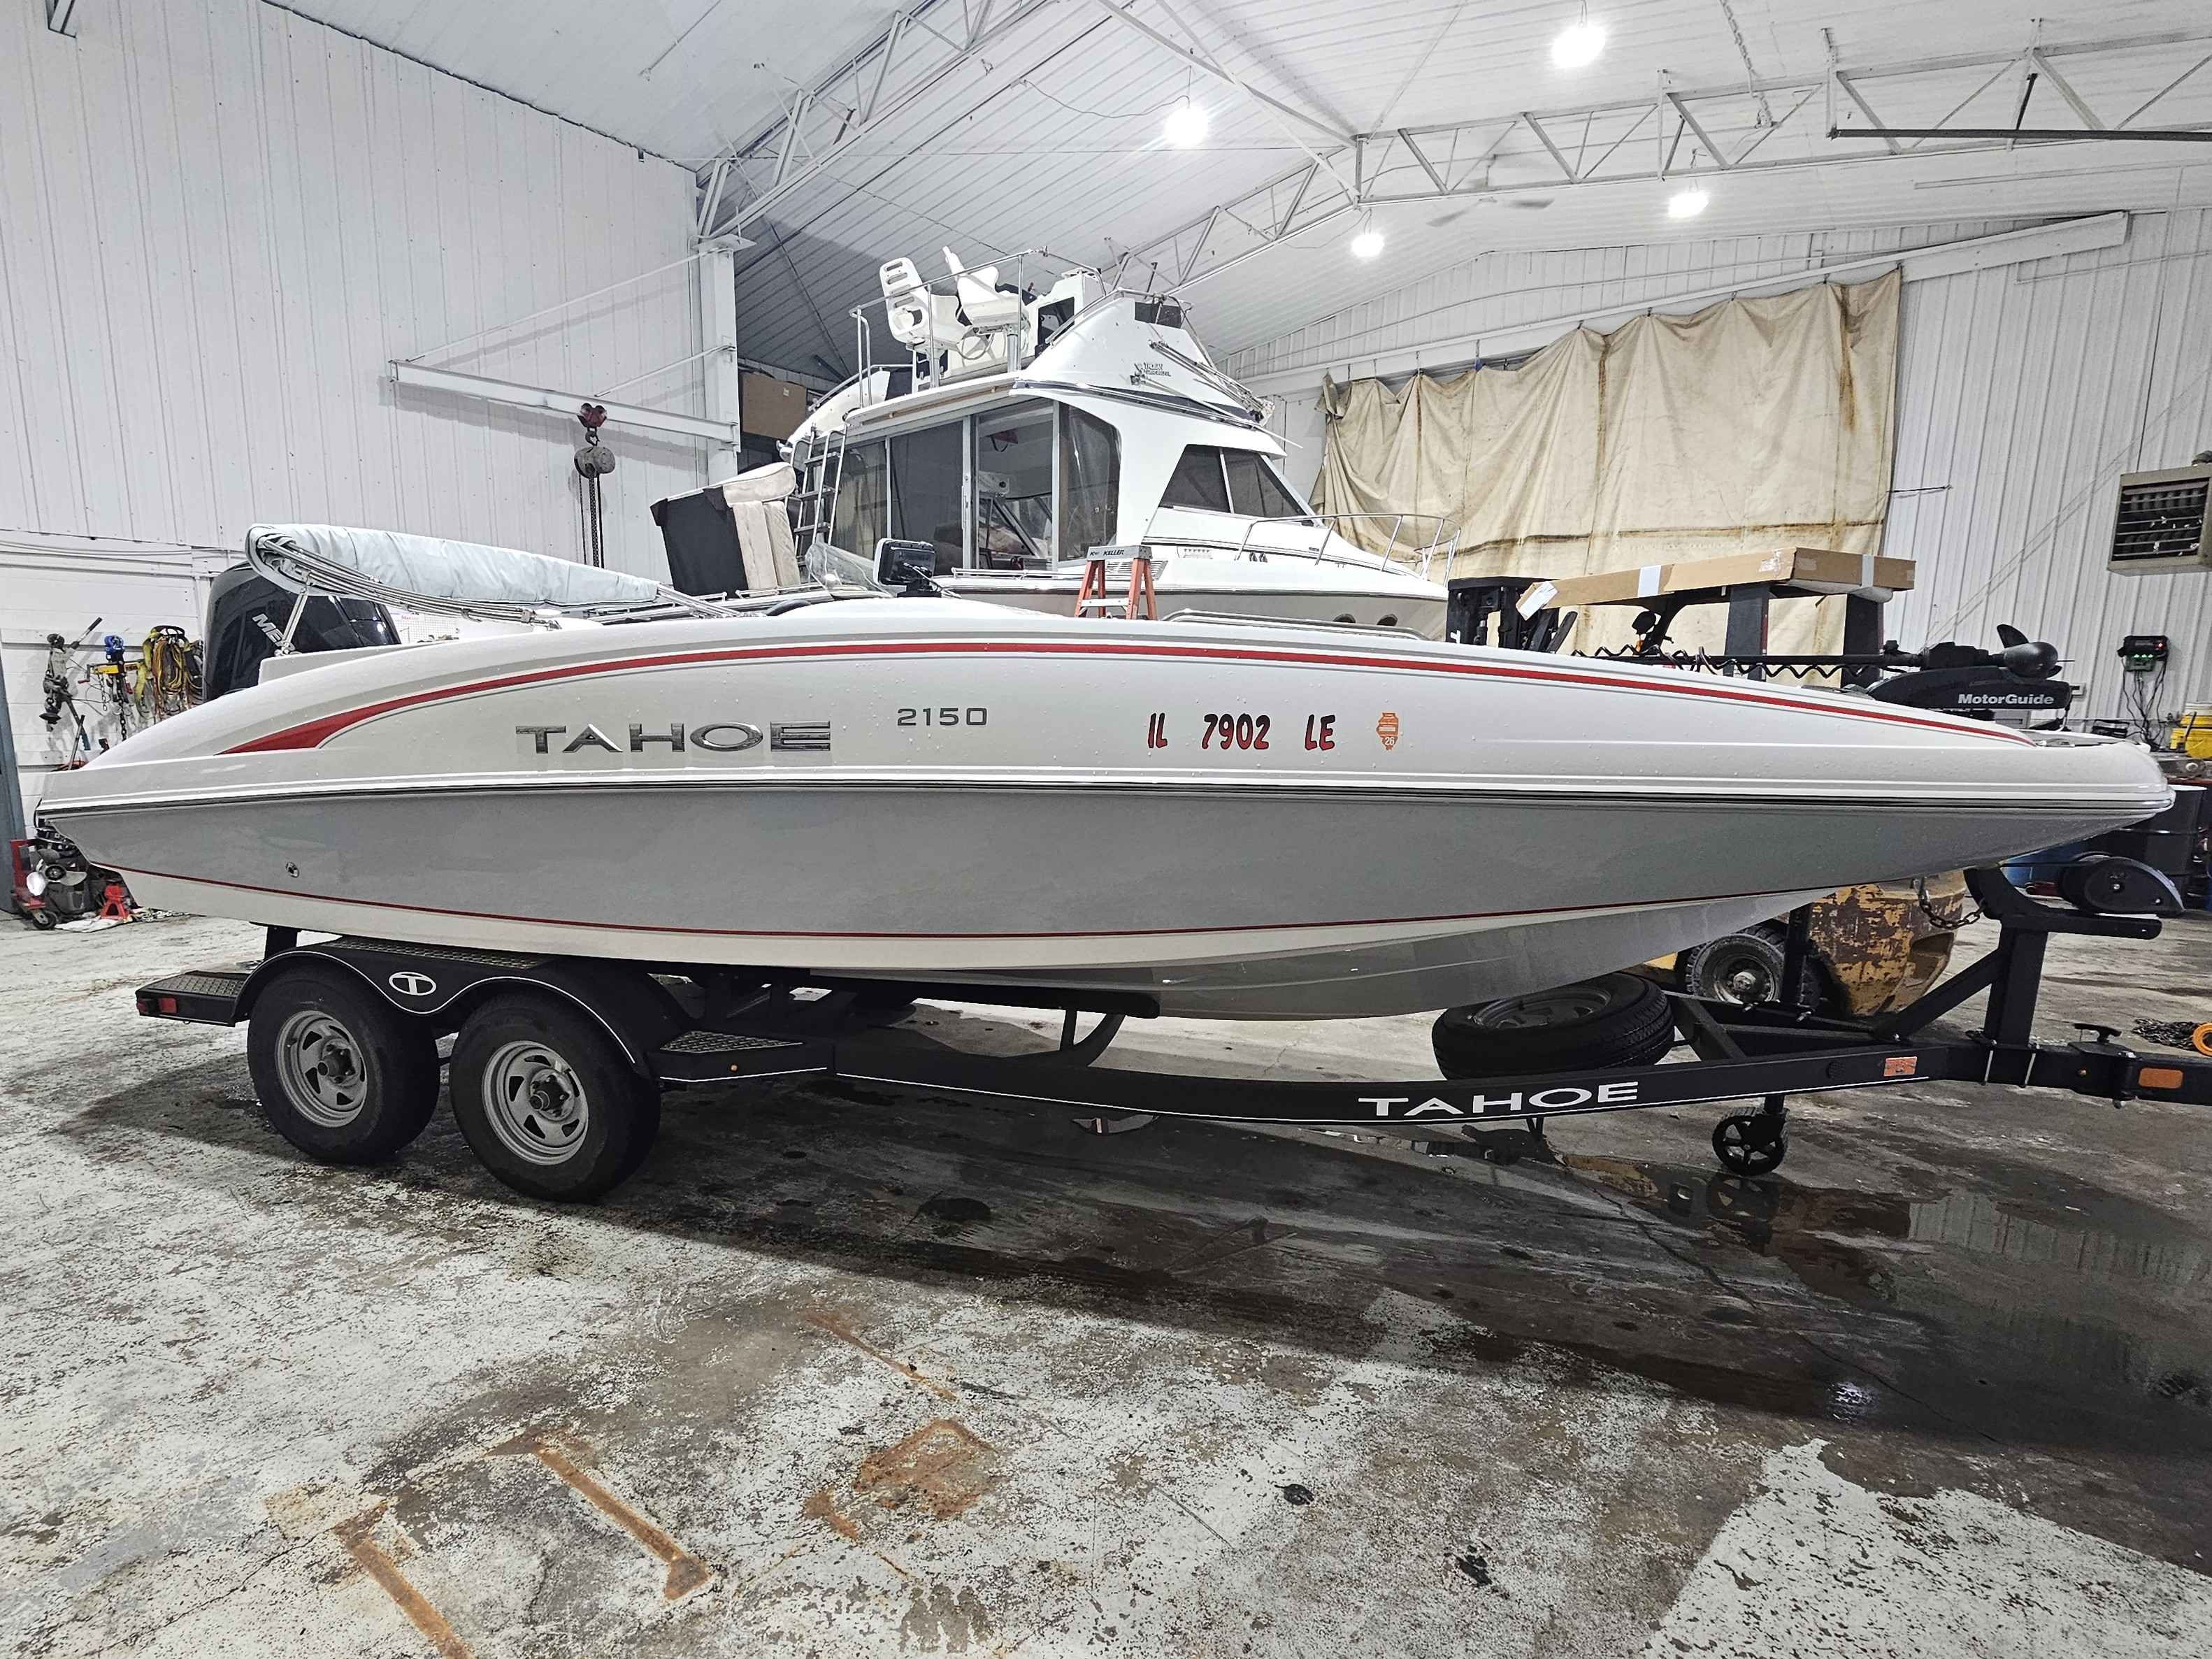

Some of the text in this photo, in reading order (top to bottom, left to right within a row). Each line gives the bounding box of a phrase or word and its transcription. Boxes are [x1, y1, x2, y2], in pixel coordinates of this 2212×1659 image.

[1958, 694, 2054, 704] MotorGuide
[898, 708, 987, 726] 2150
[516, 721, 831, 753] TAHOE
[1148, 713, 1335, 750] IL 7902 LE
[1384, 736, 1395, 746] 26
[1358, 1082, 1638, 1116] TAHOE
